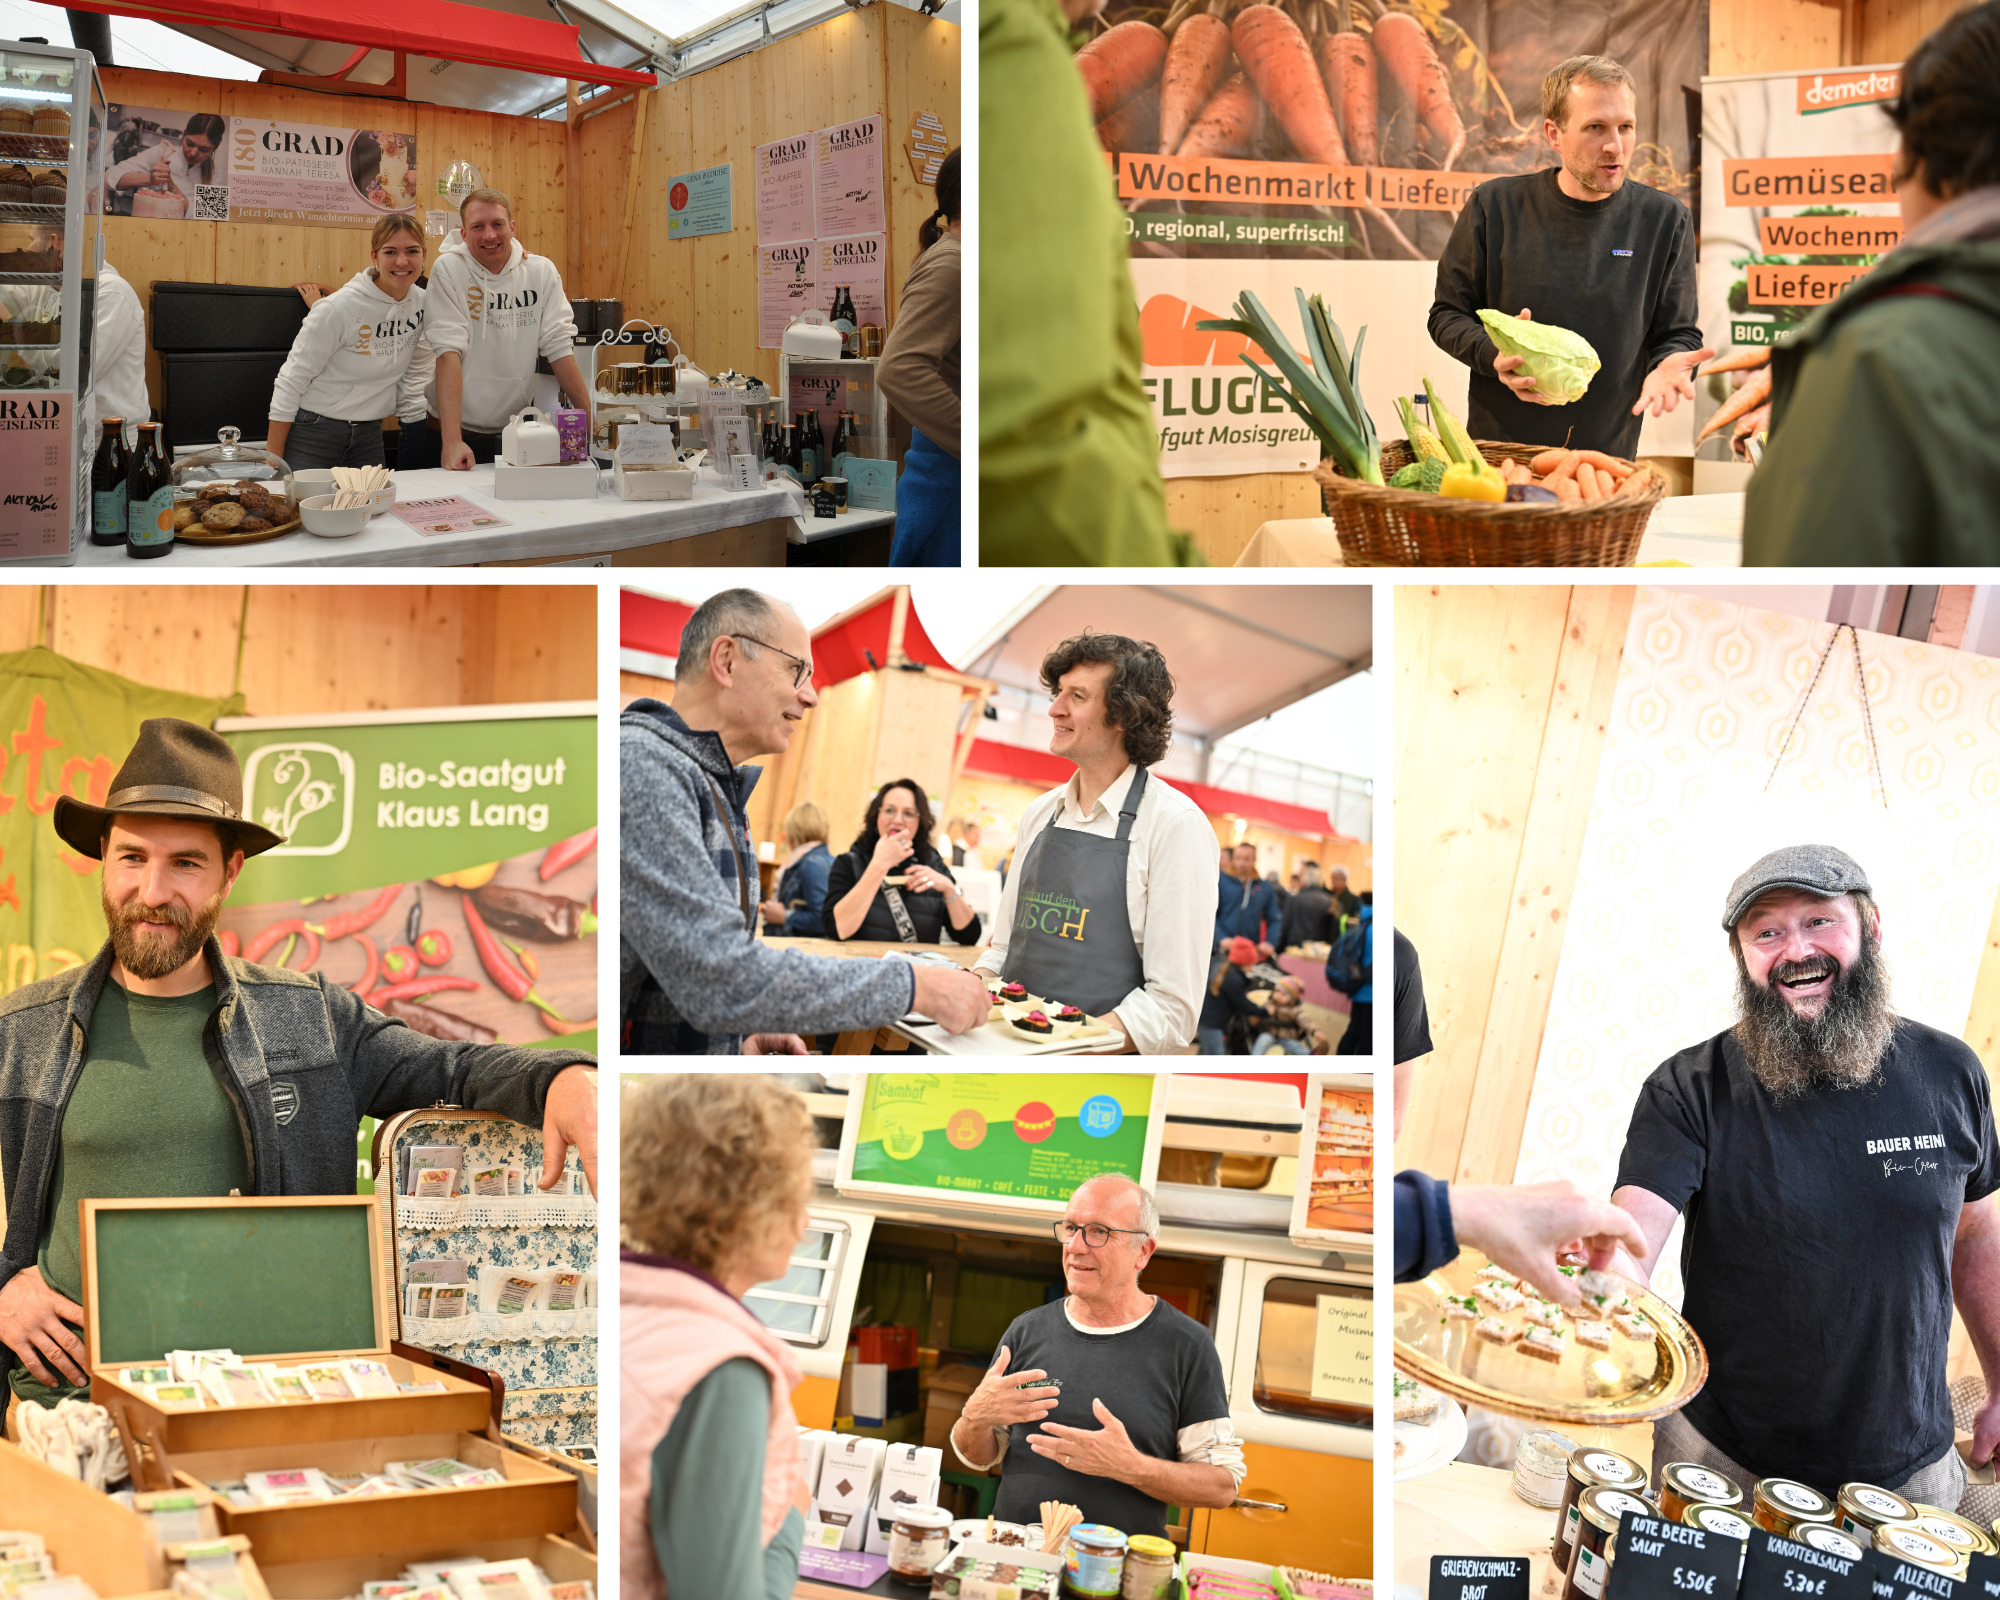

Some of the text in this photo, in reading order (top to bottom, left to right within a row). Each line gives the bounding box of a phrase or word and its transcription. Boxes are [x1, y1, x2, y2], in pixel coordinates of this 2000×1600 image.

[1805, 72, 1898, 104] demeter
[262, 131, 344, 156] GRAD
[830, 123, 874, 145] GRAD
[770, 140, 807, 160] GRAD
[830, 136, 875, 153] PREISLISTE
[262, 156, 337, 171] BIO-PATISSERIE
[770, 152, 807, 167] PREISLISTE
[262, 166, 340, 180] HANNAH TERESA
[707, 168, 728, 179] LOUISE
[764, 171, 802, 186] BIO-KAFFEE
[1128, 161, 1356, 201] Wochenmarkt
[238, 207, 262, 218] Jetzt
[264, 209, 294, 219] direkt
[297, 211, 364, 223] Wunschtermin
[1146, 220, 1231, 242] regional,
[1235, 222, 1345, 244] superfrisch!
[772, 246, 810, 262] GRAD
[833, 241, 877, 257] GRAD
[834, 255, 877, 266] SPECIALS
[1734, 325, 1769, 344] BIO,
[802, 378, 841, 389] GRAD
[378, 756, 567, 793] Bio-Saatgut
[377, 799, 550, 832] Klaus Lang
[1035, 892, 1077, 908] auf den
[879, 1082, 927, 1101] Samhof
[1866, 1134, 1946, 1155] BAUER HEINI
[992, 1181, 1014, 1194] CAFÉ
[1023, 1184, 1049, 1198] FESTE
[1328, 1307, 1368, 1320] Original
[1355, 1351, 1371, 1361] für
[1631, 1516, 1707, 1550] ROTE BEETE
[1630, 1536, 1665, 1558] SALAT
[1767, 1536, 1854, 1577] KAROTTENSALAT
[1440, 1559, 1522, 1579] GRIEBENSCHMALZ-
[1872, 1580, 1895, 1599] VOM
[1893, 1563, 1954, 1599] ALLERLEI
[1461, 1585, 1489, 1600] BROT
